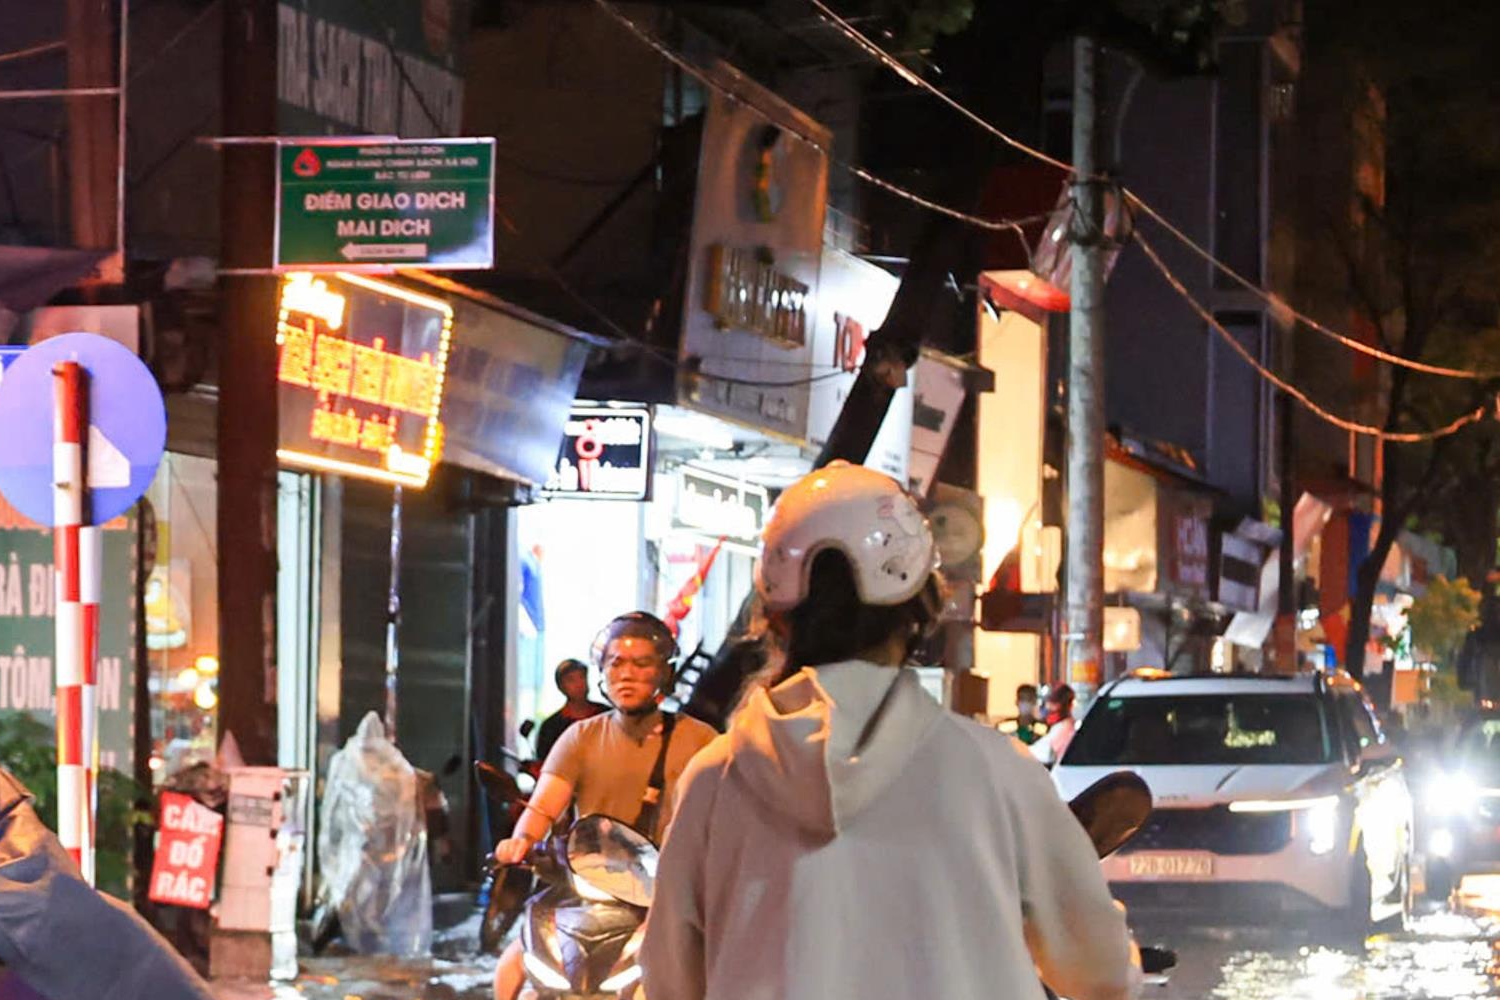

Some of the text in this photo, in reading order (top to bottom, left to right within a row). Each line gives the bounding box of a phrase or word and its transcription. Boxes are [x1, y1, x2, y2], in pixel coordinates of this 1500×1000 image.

[356, 192, 411, 210] GIAO
[415, 191, 466, 211] DỊCH
[337, 220, 376, 237] MAI
[156, 870, 206, 901] RÁC
